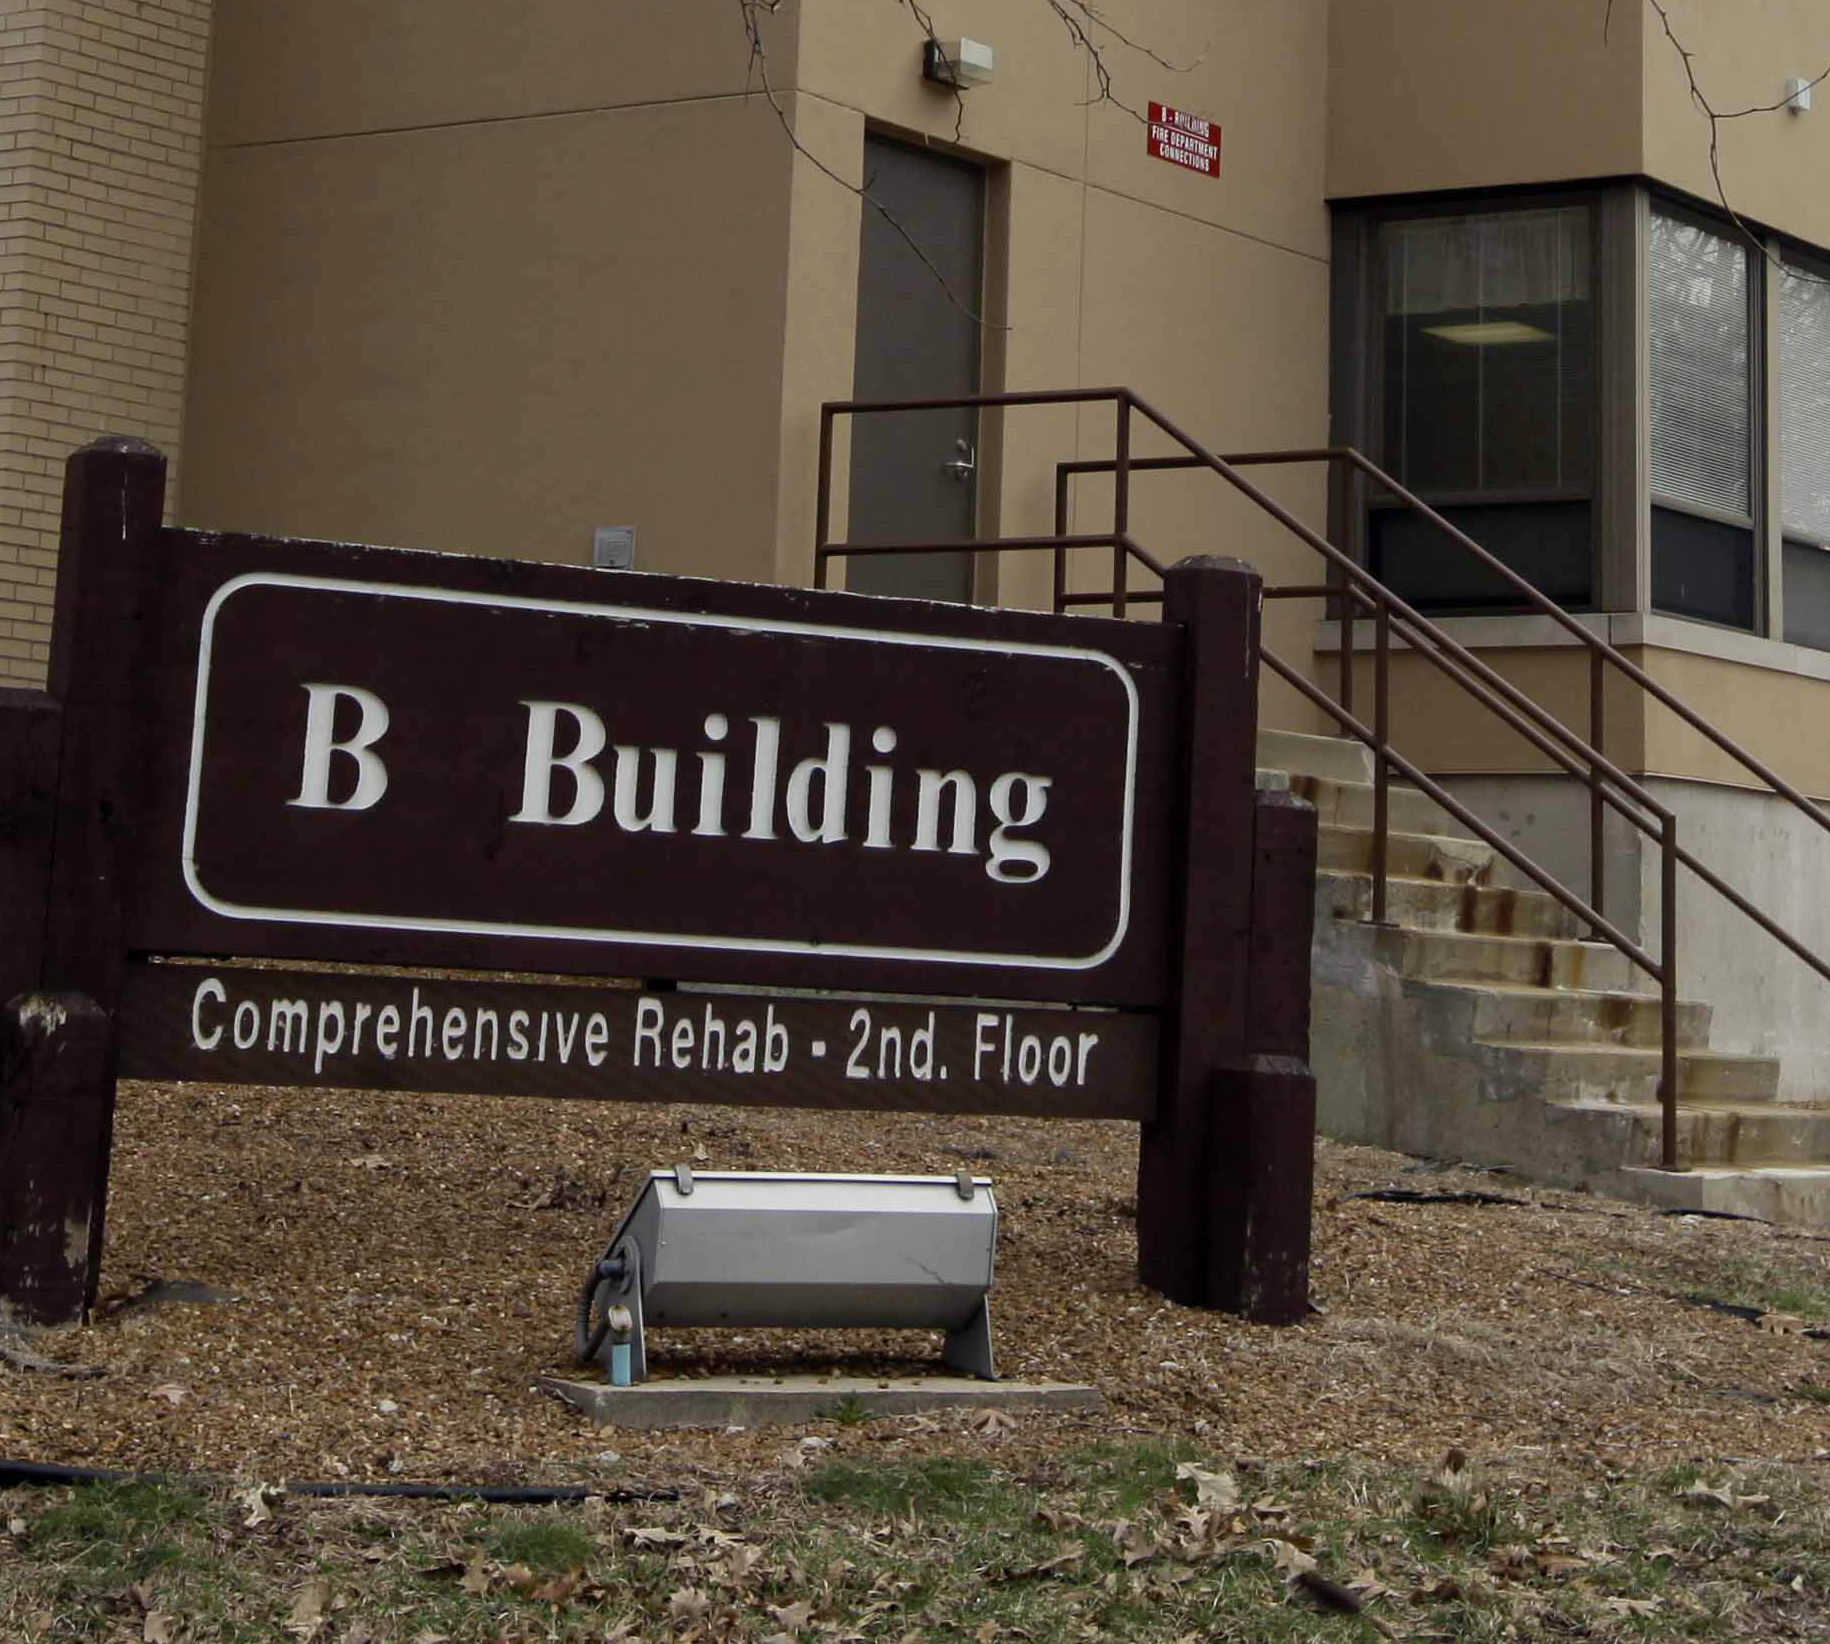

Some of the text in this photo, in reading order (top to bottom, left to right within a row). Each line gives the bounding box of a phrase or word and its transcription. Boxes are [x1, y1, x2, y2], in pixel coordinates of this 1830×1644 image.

[1152, 124, 1218, 160] FIRE DEPARTMENT
[1174, 111, 1210, 137] BUILDING
[1160, 143, 1210, 172] CONNECTIONS
[287, 683, 1052, 884] B Building
[191, 977, 610, 1075] Comprehensive
[633, 996, 790, 1074] Rehab
[845, 1007, 949, 1080] 2nd.
[973, 1012, 1100, 1087] Floor
